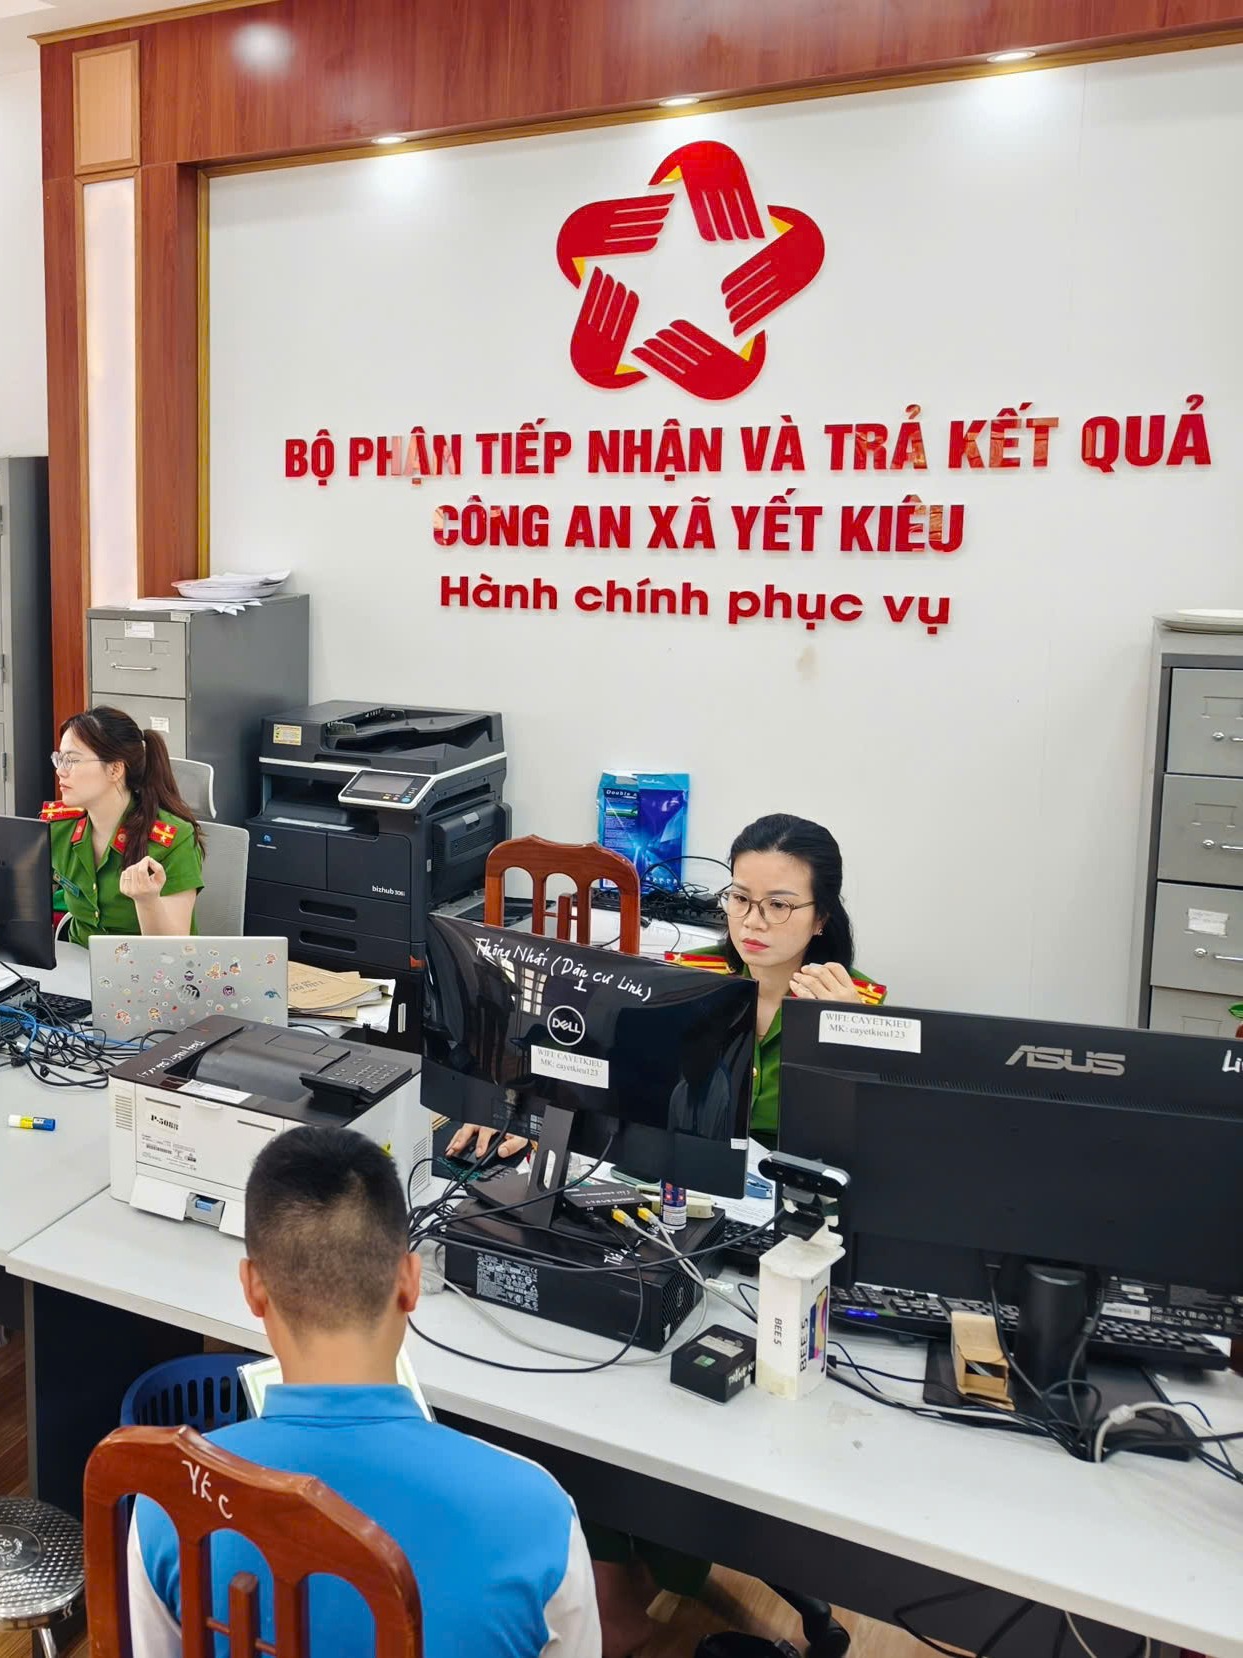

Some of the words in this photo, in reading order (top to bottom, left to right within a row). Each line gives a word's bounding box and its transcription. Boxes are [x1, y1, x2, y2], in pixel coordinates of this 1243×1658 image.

[285, 428, 335, 486] BỘ
[349, 426, 462, 485] PHẬN
[476, 418, 571, 475] TIẾP
[588, 418, 723, 481] NHẬN
[740, 414, 805, 472] VÀ
[824, 404, 928, 470] TRẢ
[948, 402, 1059, 469] KẾT
[1080, 394, 1212, 473] QUẢ
[433, 494, 549, 547] CÔNG
[564, 505, 631, 548] AN
[648, 496, 716, 549] XÃ
[731, 487, 822, 552] YẾT
[840, 494, 964, 553] KIÊU
[440, 573, 558, 610] Hành
[574, 577, 709, 616] chính
[729, 584, 863, 630] phục
[883, 595, 950, 635] vụ
[372, 885, 394, 895] bizhub
[475, 938, 511, 961] Thống
[513, 944, 549, 967] Nhất
[550, 955, 589, 979] (Dân
[592, 970, 614, 985] cư
[617, 975, 652, 1002] Linh)
[552, 1017, 581, 1034] DELL
[850, 1027, 905, 1039] cayetkieu123
[851, 1015, 912, 1029] CAYETKIEU
[1005, 1044, 1126, 1077] ASUS
[1222, 1050, 1243, 1073] Li
[773, 1317, 783, 1338] BEE
[773, 1338, 782, 1347] 5
[800, 1335, 808, 1372] BEE
